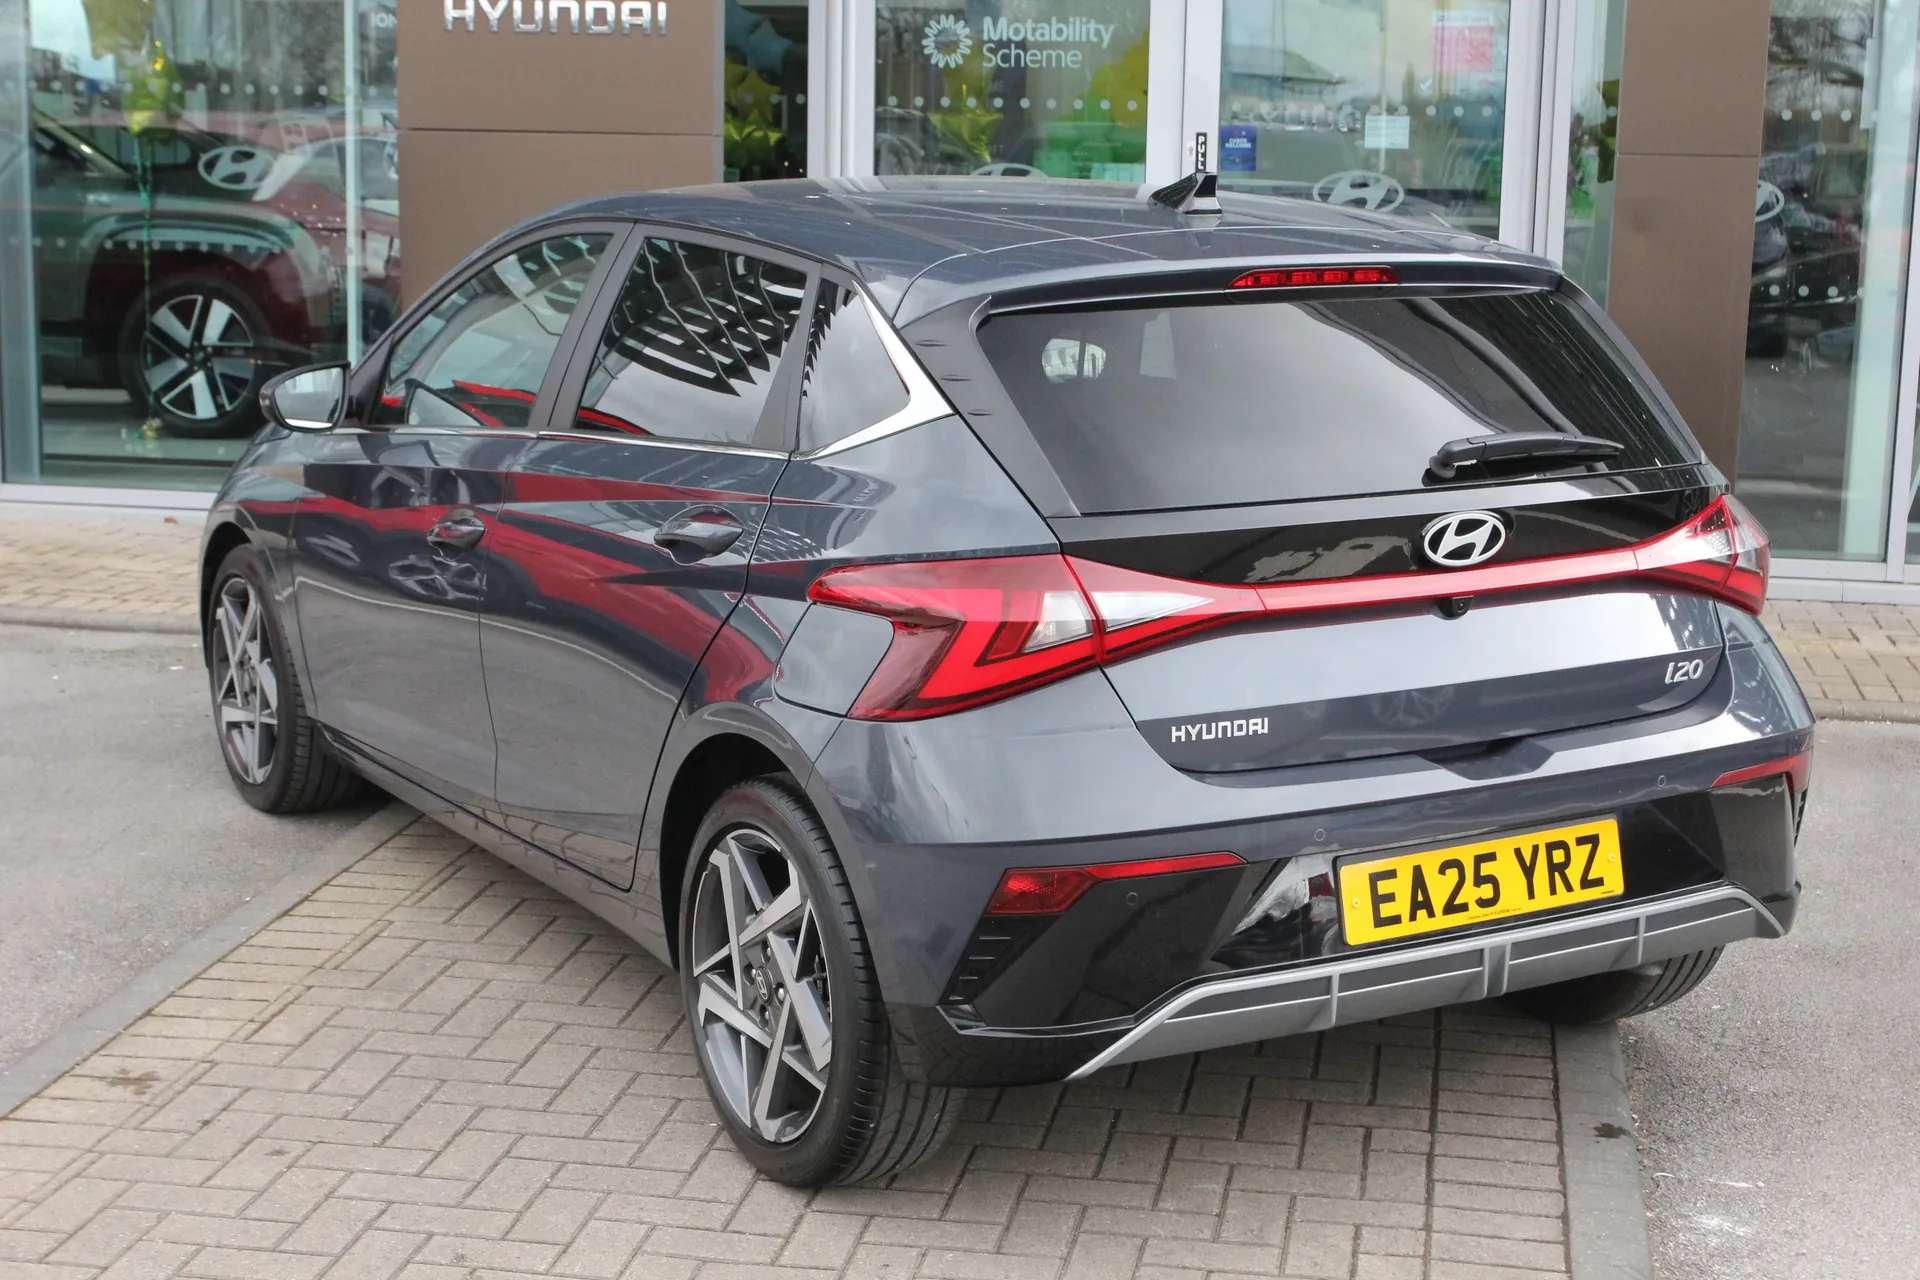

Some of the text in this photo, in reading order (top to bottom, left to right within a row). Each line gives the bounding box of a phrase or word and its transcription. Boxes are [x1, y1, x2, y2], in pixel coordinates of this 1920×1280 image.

[444, 0, 667, 35] HYUNDAI
[983, 16, 1115, 48] Motability
[982, 43, 1082, 68] Scheme
[1171, 717, 1269, 743] HYUNDAI
[1368, 833, 1604, 928] EA25 YRZ
